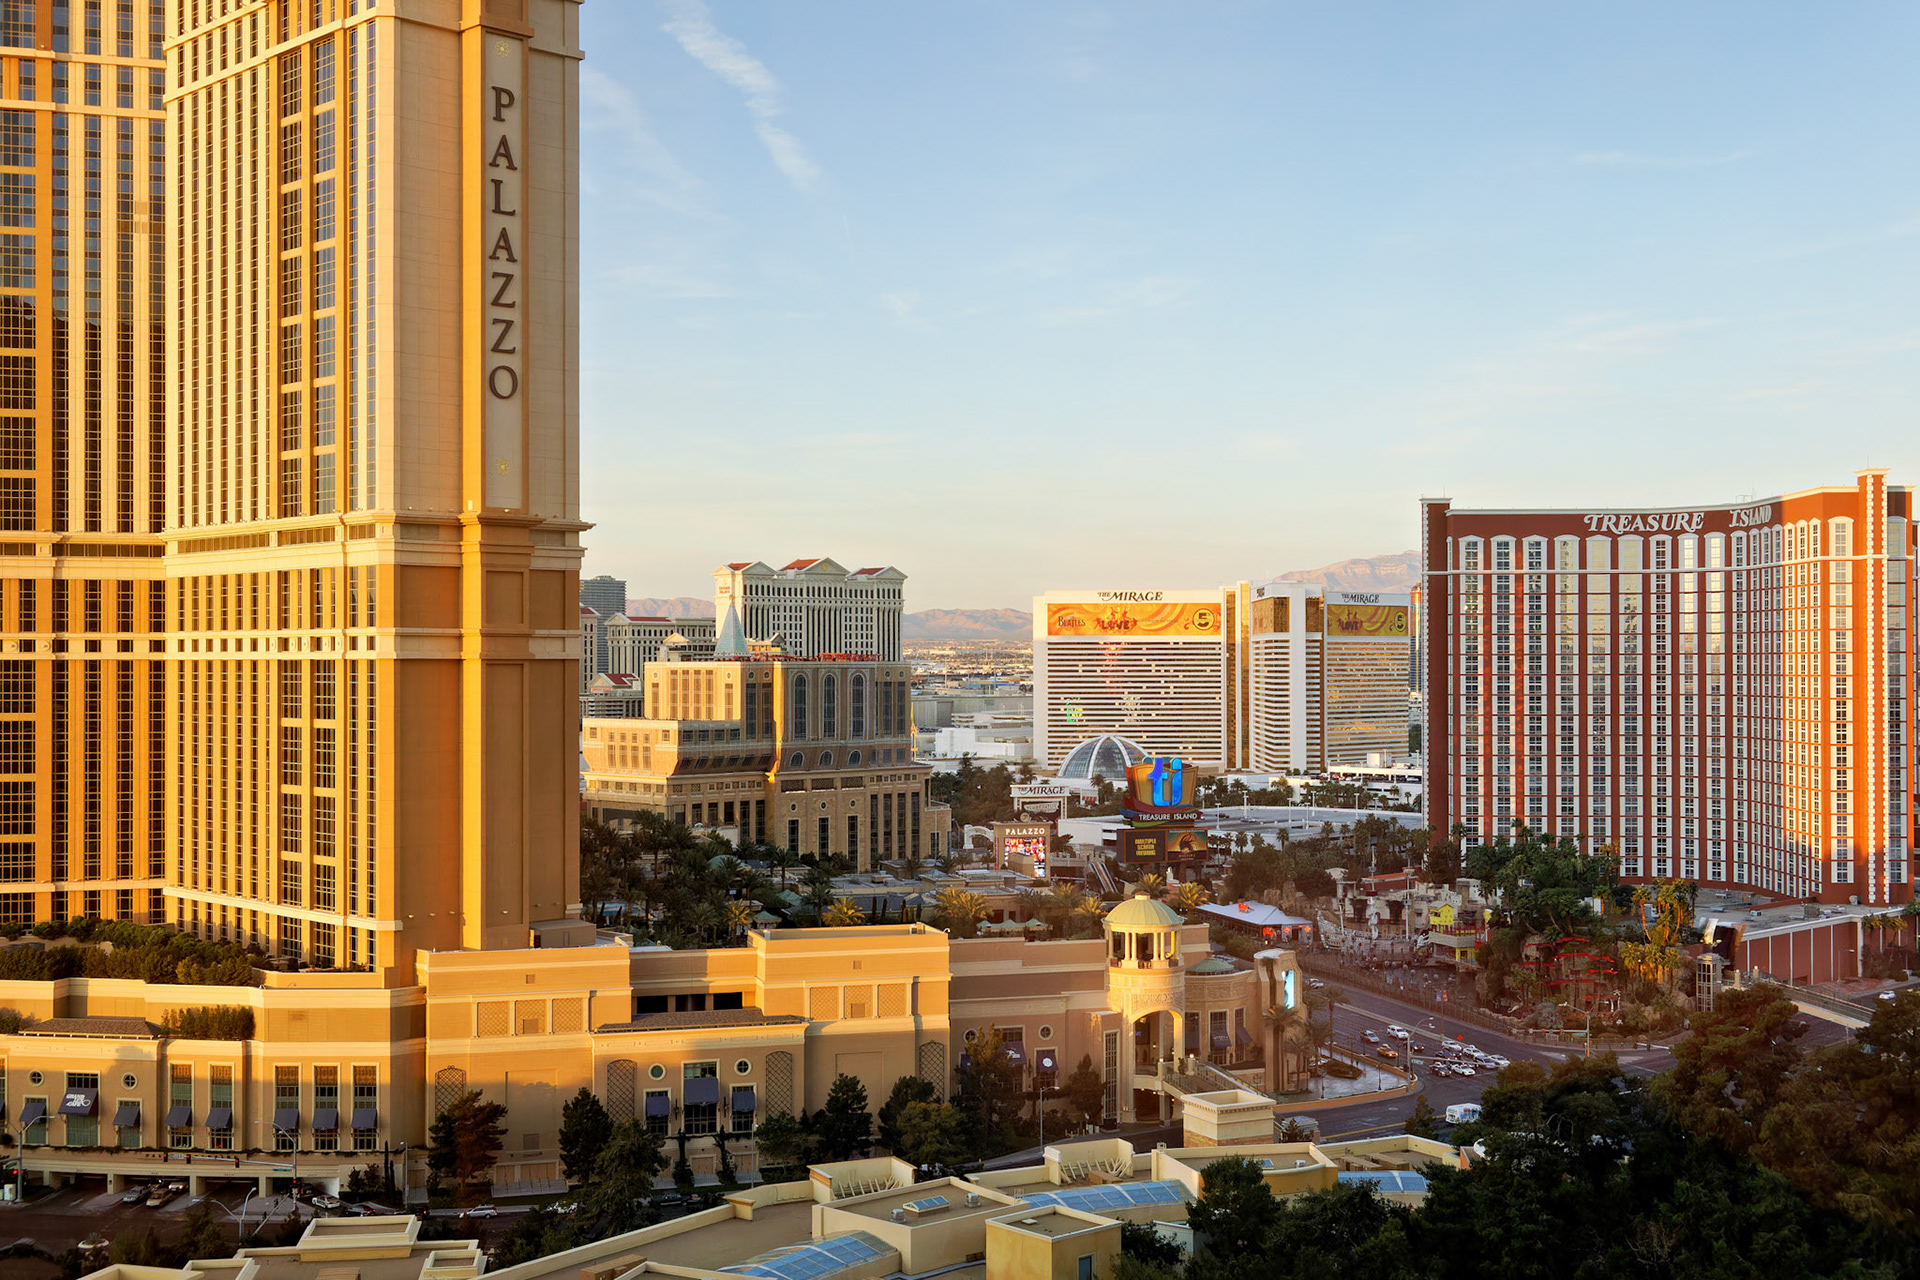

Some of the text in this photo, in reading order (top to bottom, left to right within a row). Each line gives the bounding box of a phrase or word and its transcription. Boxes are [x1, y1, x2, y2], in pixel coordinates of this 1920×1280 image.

[489, 85, 518, 400] PALAZZO
[1584, 505, 1772, 535] TREASURE ISLAND
[1102, 592, 1163, 602] MIRAGE
[1344, 594, 1380, 604] MIRAGE
[1020, 785, 1065, 795] MIRAGE
[1174, 812, 1198, 820] ISLAND
[1005, 827, 1045, 836] PALAZZO
